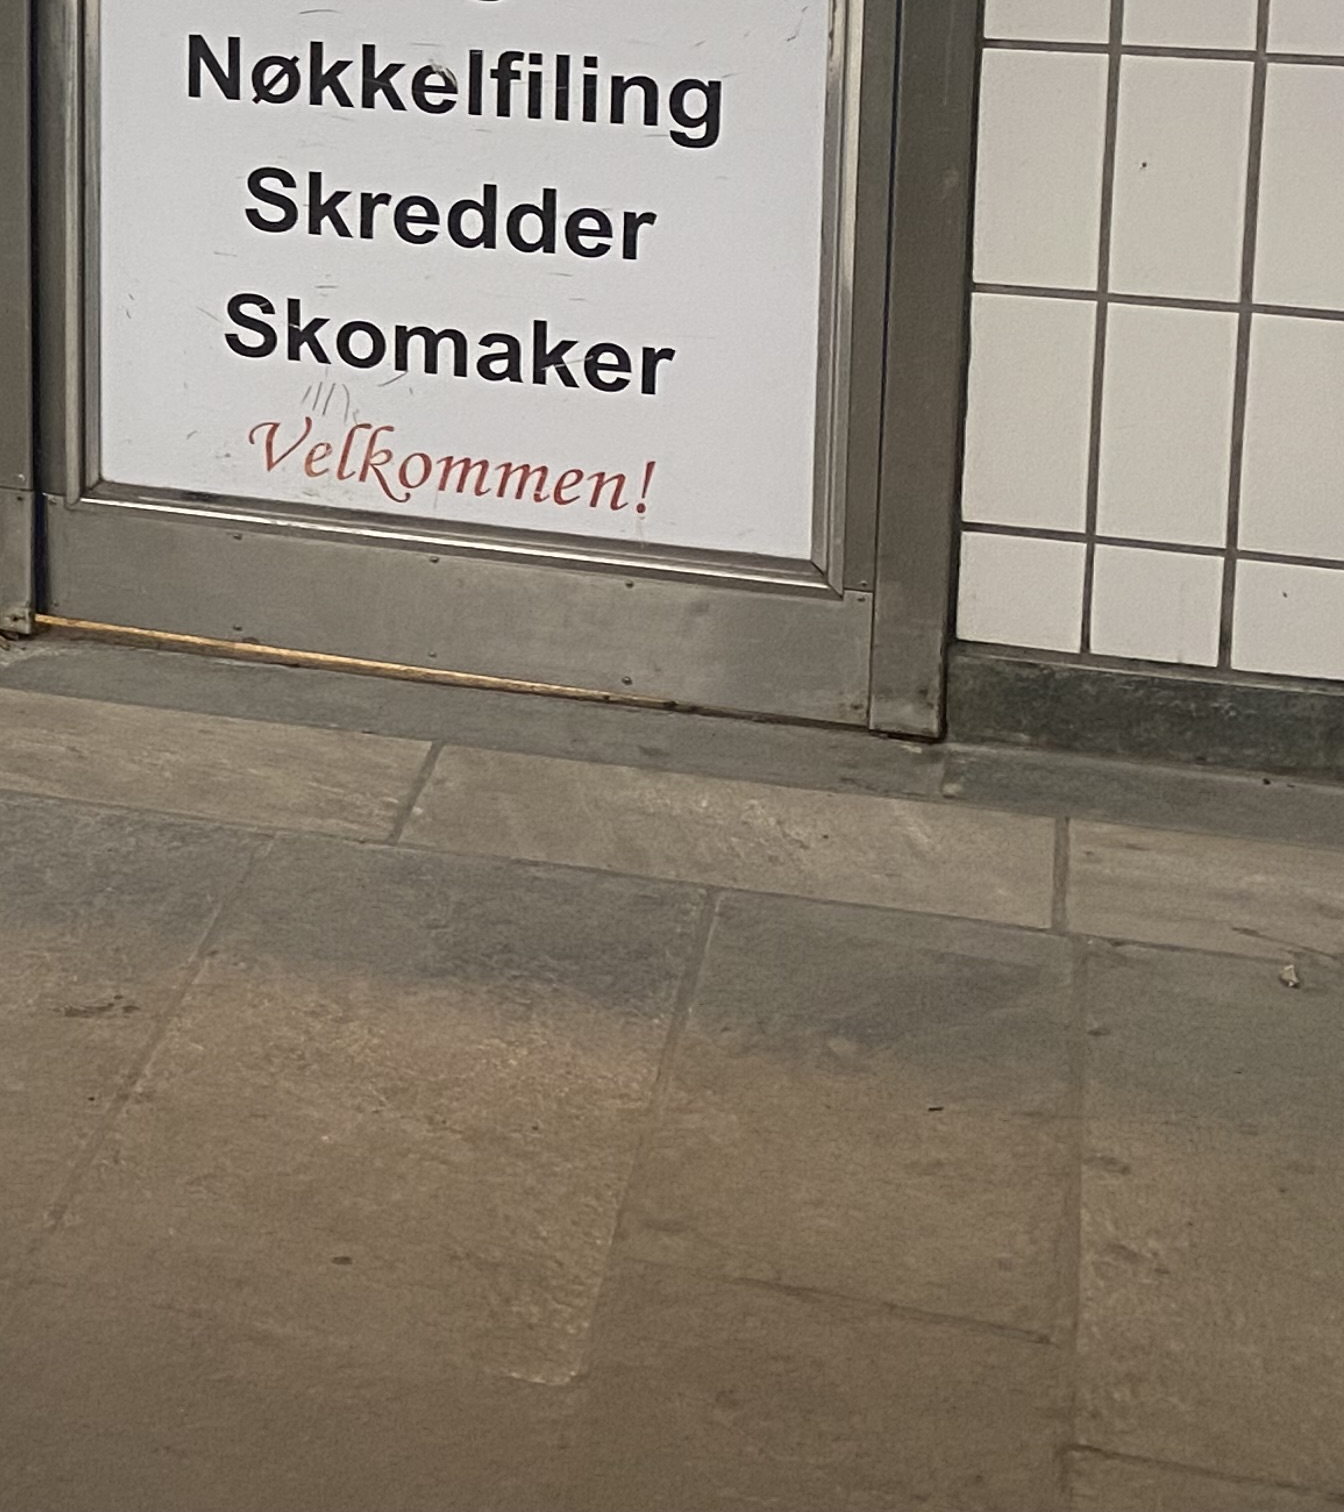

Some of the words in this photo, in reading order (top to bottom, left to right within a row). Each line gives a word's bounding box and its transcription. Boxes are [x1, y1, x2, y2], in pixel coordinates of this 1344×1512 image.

[188, 34, 722, 149] Nøkkelfiling
[245, 166, 657, 260] Skredder
[224, 292, 675, 395] Skomaker
[249, 416, 656, 514] Velkommen!
